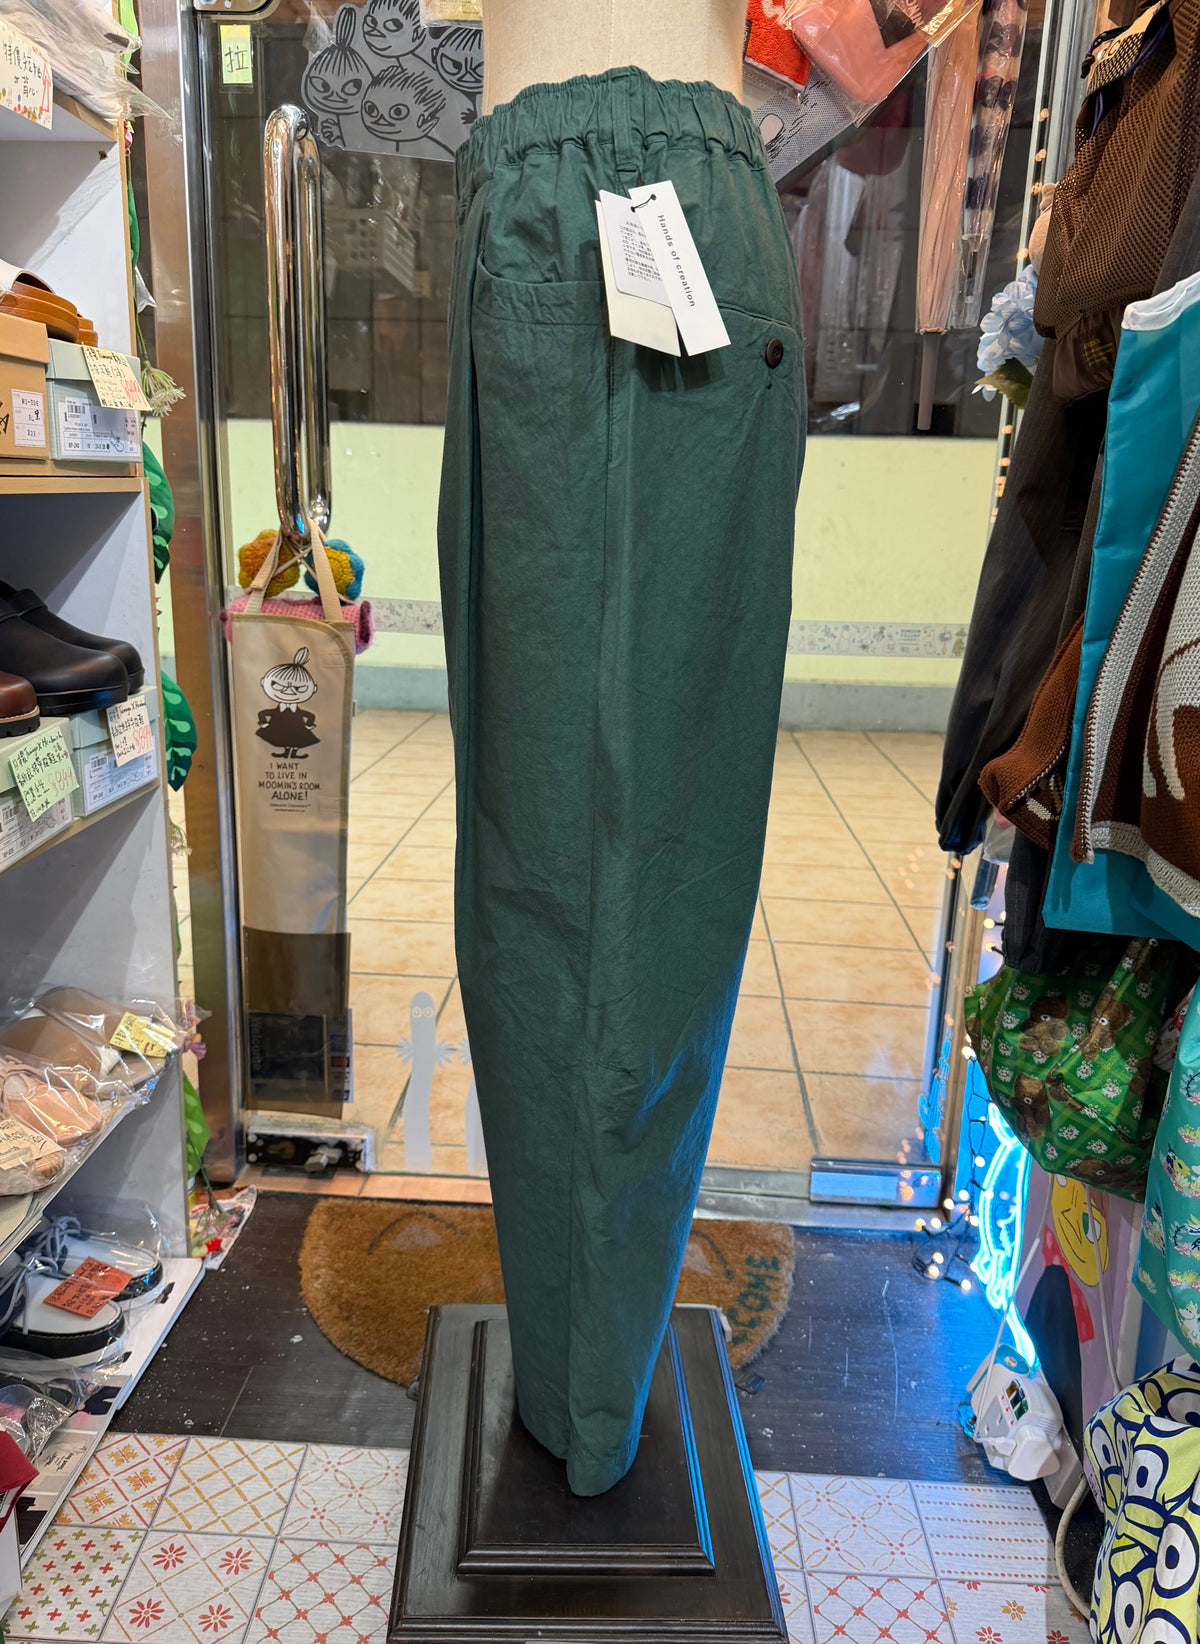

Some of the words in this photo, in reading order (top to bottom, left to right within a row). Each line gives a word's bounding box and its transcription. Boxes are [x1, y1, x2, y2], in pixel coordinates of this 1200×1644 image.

[224, 45, 249, 73] 拉
[657, 214, 674, 247] Hands
[671, 250, 681, 262] of
[675, 264, 696, 308] creation
[276, 762, 300, 770] WANT
[265, 771, 275, 780] TO
[277, 771, 295, 780] LIVE
[298, 771, 307, 780] IN
[258, 780, 297, 790] MOOMIN'S
[299, 782, 320, 791] ROOM
[271, 790, 308, 801] ALONE!
